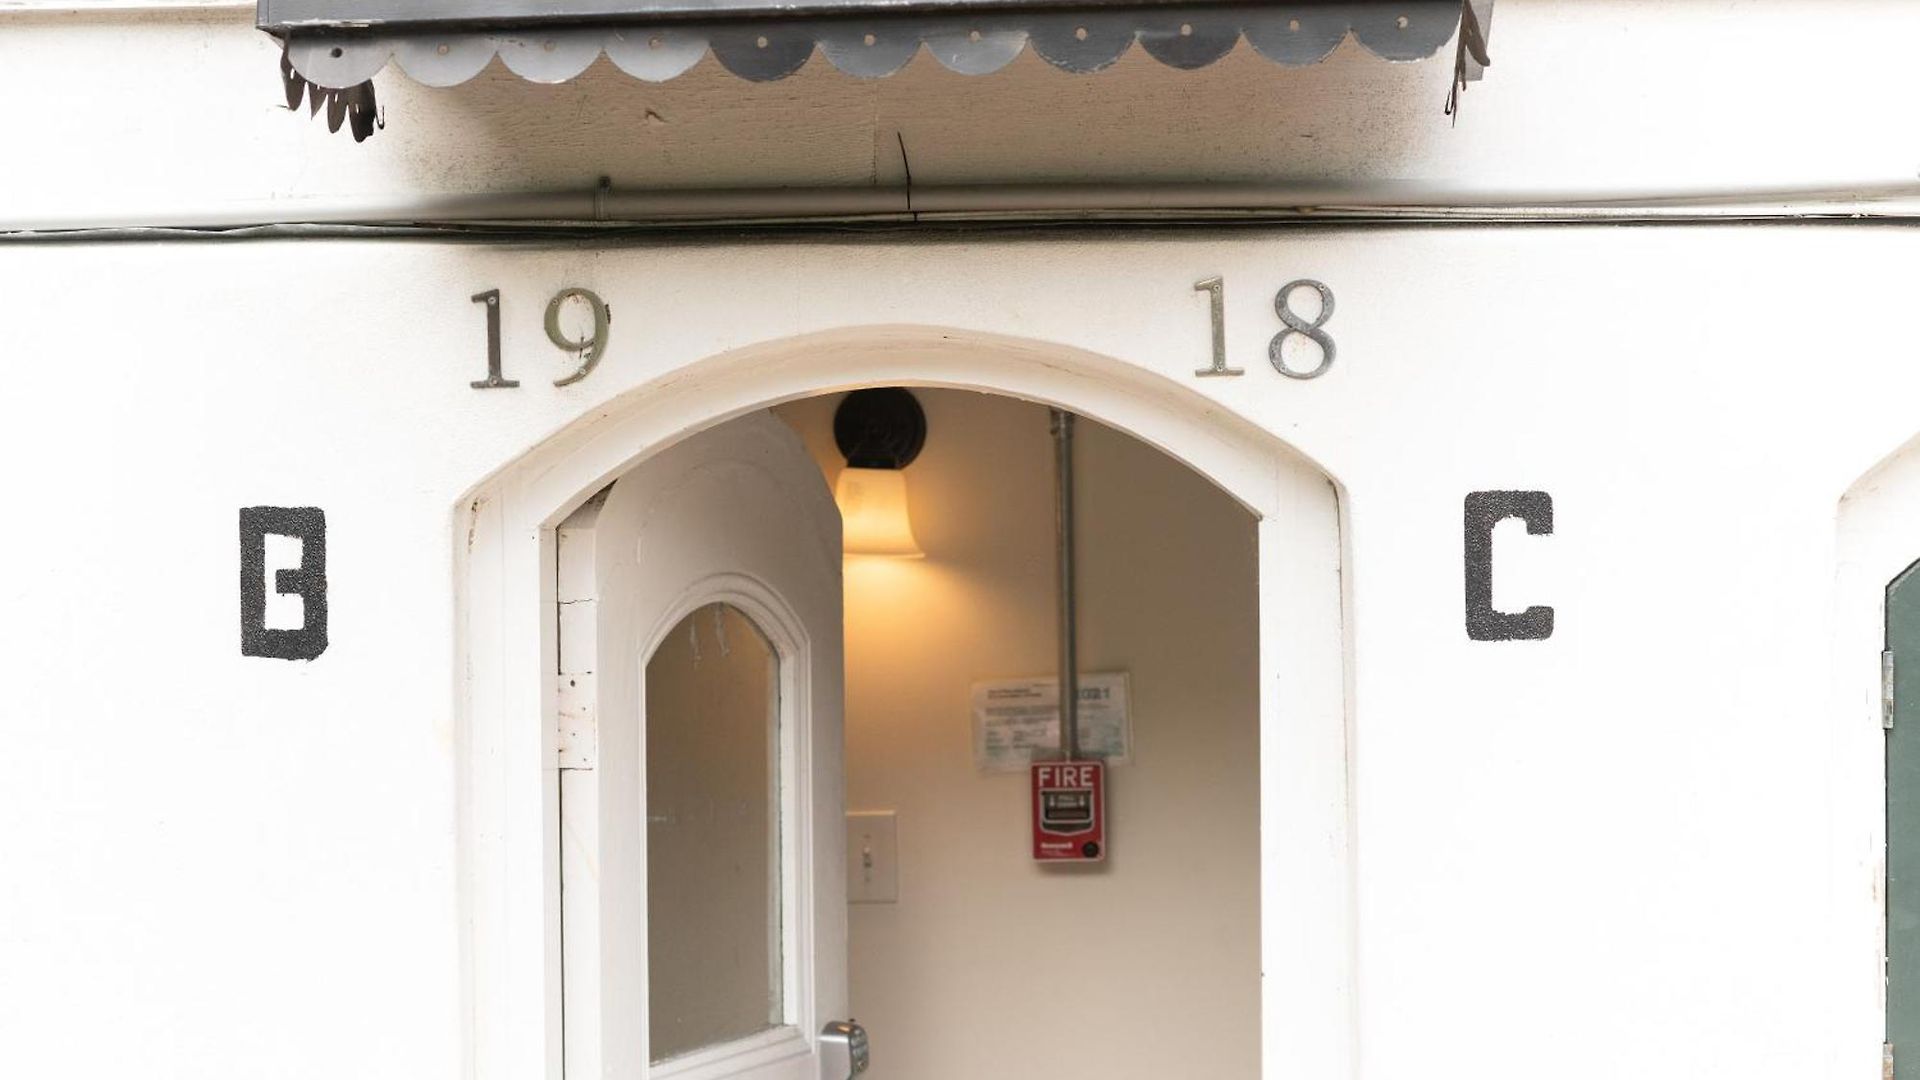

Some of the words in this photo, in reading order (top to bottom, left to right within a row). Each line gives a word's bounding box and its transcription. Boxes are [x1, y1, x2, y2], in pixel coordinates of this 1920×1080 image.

[470, 287, 609, 389] 19
[1194, 276, 1336, 380] 18
[239, 505, 328, 661] B
[1464, 490, 1554, 641] C
[1039, 767, 1093, 787] FIRE
